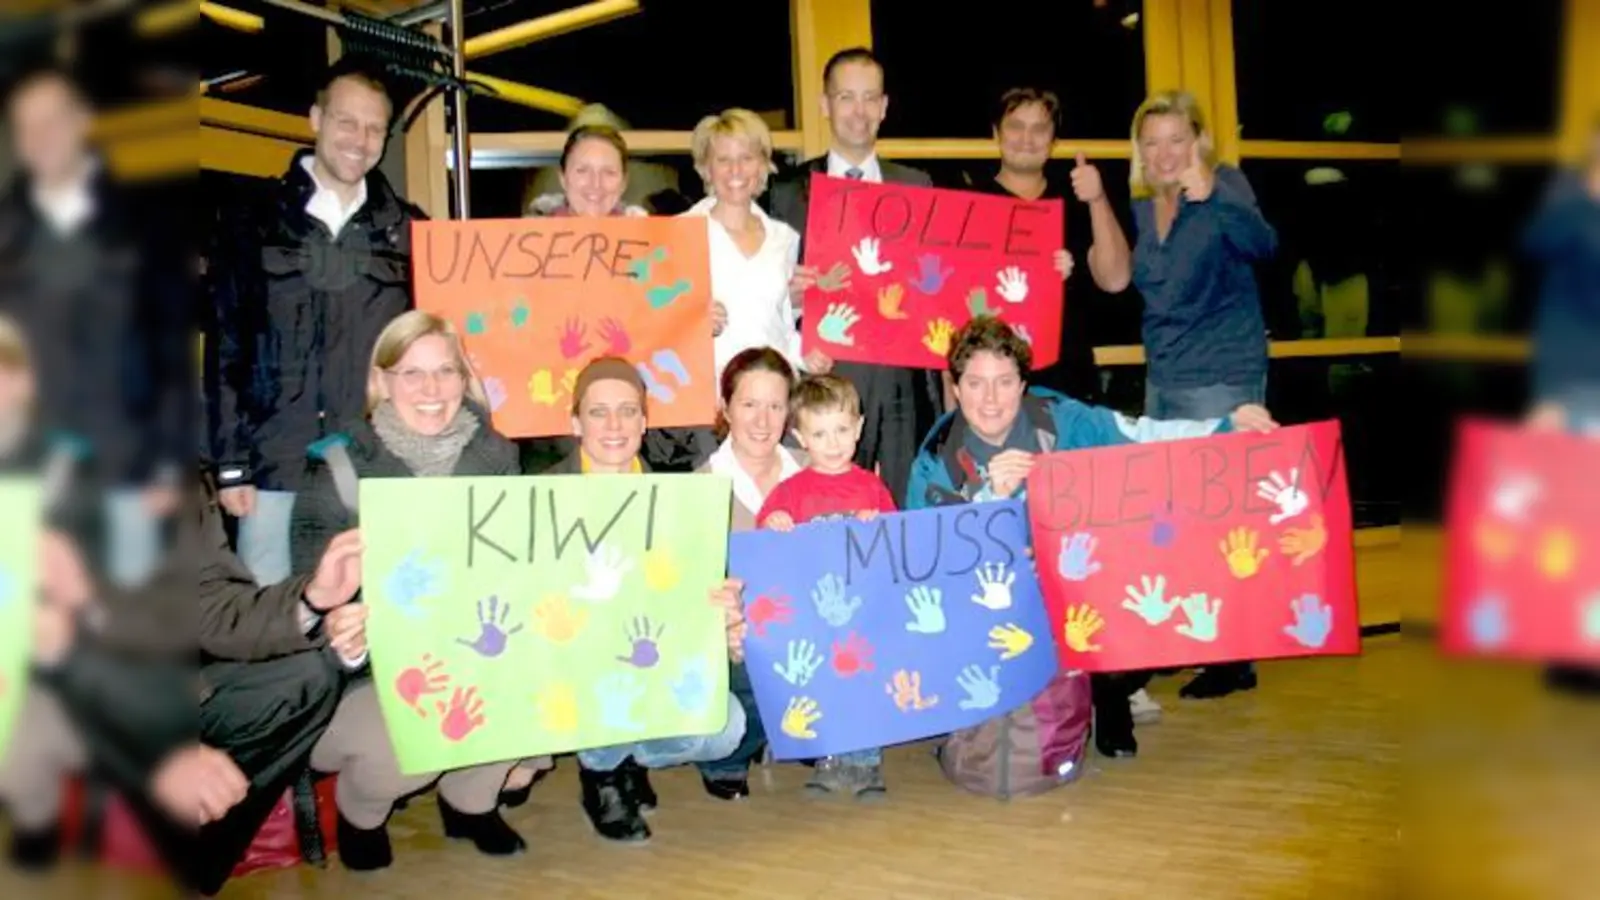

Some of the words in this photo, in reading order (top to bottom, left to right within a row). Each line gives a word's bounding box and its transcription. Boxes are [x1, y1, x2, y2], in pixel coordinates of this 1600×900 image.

[426, 230, 650, 284] UNSERE
[827, 183, 1051, 255] TOLLE
[1036, 429, 1343, 532] BLEIBEN
[467, 485, 658, 568] KIWI
[844, 508, 1018, 586] MUSS
